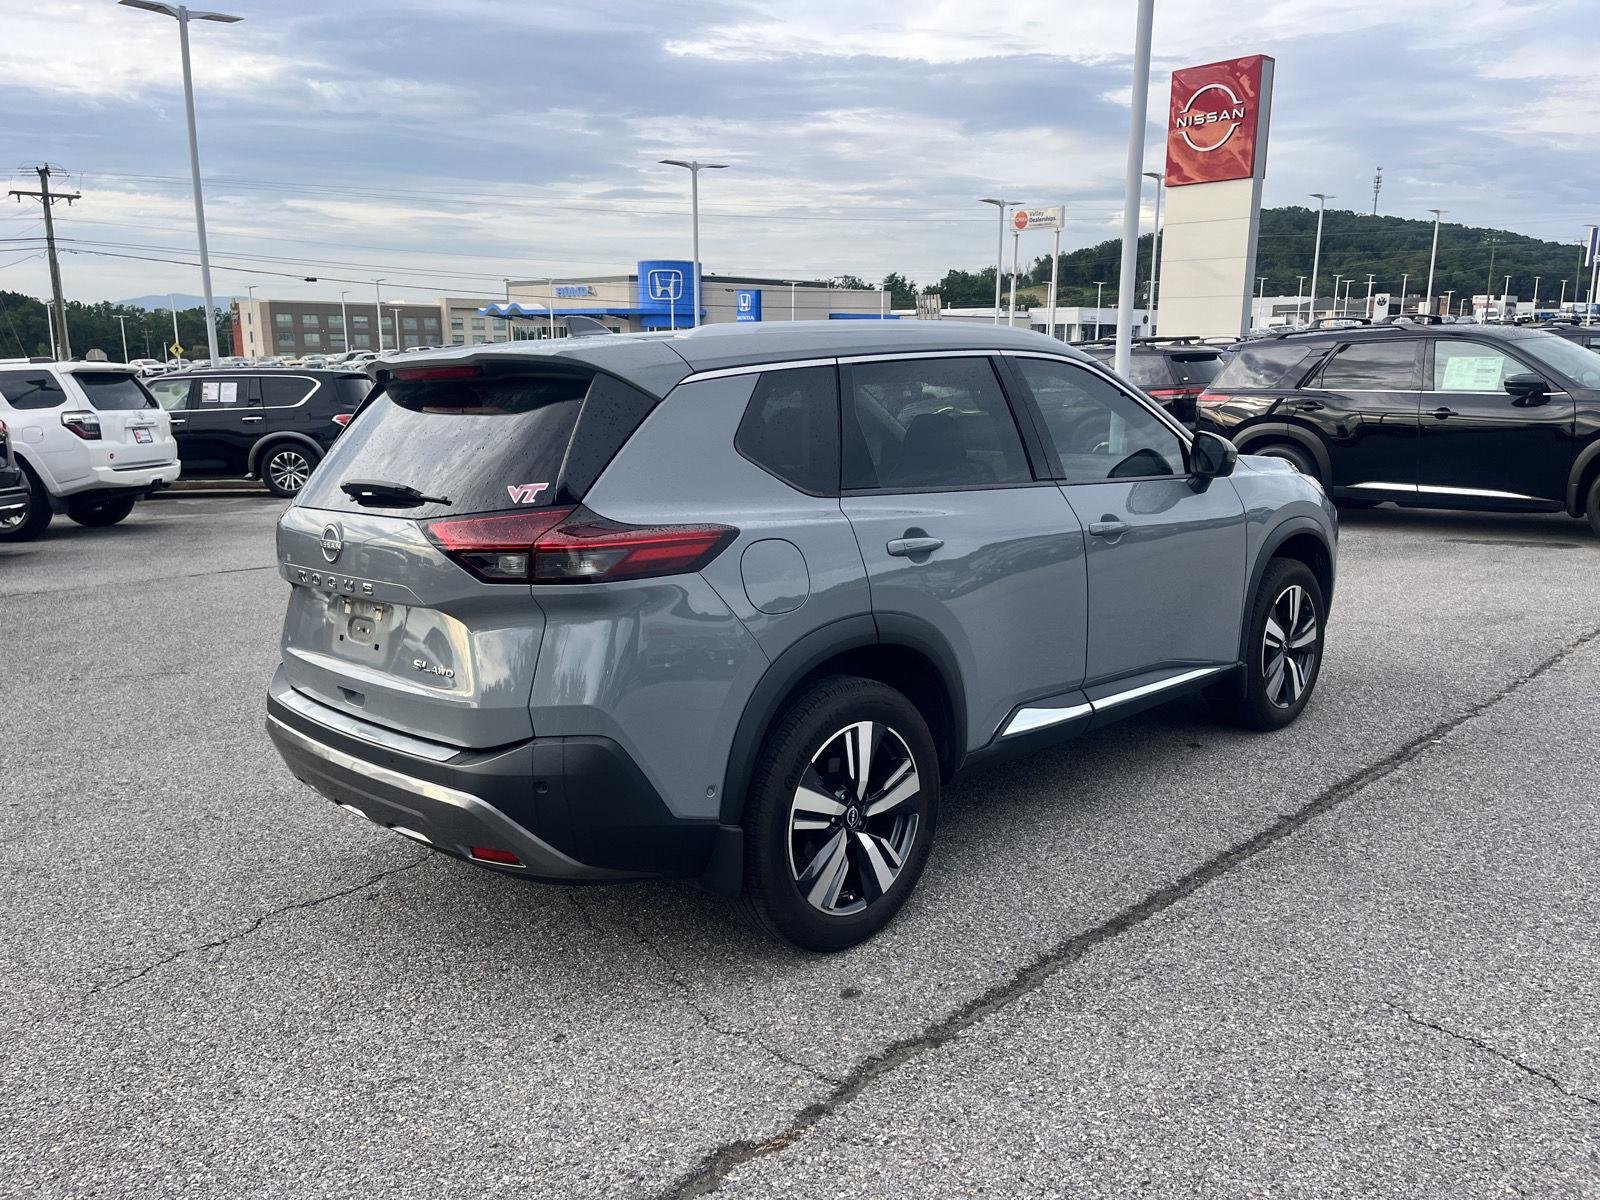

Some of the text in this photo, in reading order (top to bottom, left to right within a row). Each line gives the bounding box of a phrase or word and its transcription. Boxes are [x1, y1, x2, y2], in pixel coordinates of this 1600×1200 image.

[1176, 107, 1245, 128] NISSAN
[555, 286, 597, 298] HONDA
[507, 482, 549, 504] VT
[298, 569, 374, 596] ROGUE
[432, 665, 455, 679] AWD
